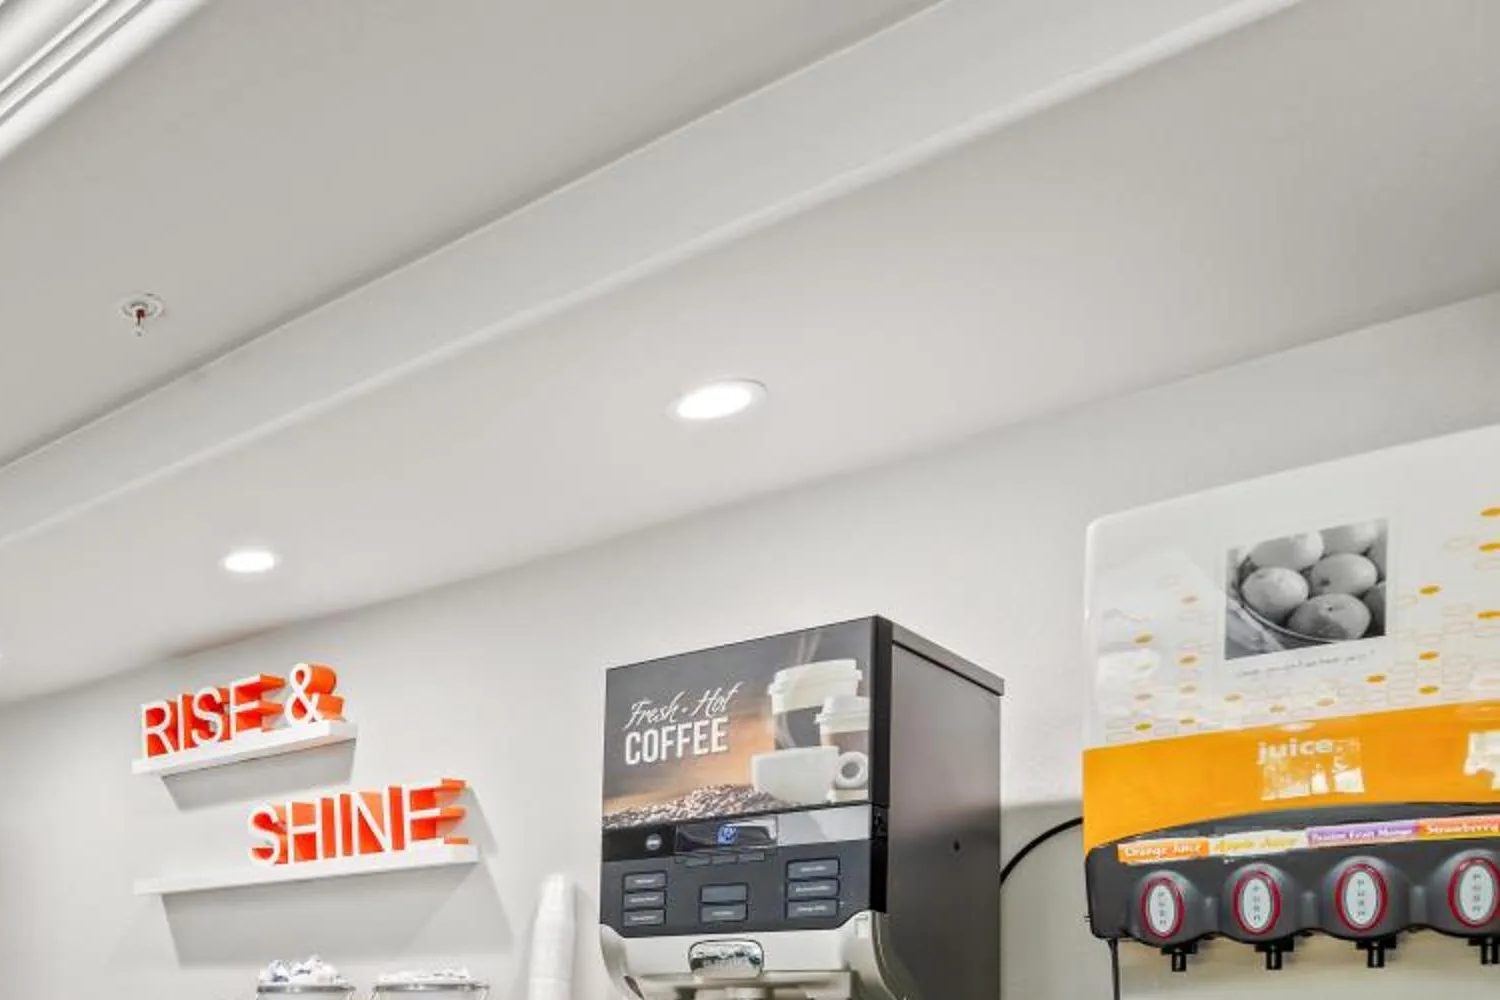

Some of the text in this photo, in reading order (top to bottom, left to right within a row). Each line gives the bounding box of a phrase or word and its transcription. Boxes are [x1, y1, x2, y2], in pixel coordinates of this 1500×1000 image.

[140, 662, 340, 758] RISE &
[623, 691, 684, 731] Fresh
[625, 716, 729, 765] COFFEE
[246, 778, 458, 868] SHINE
